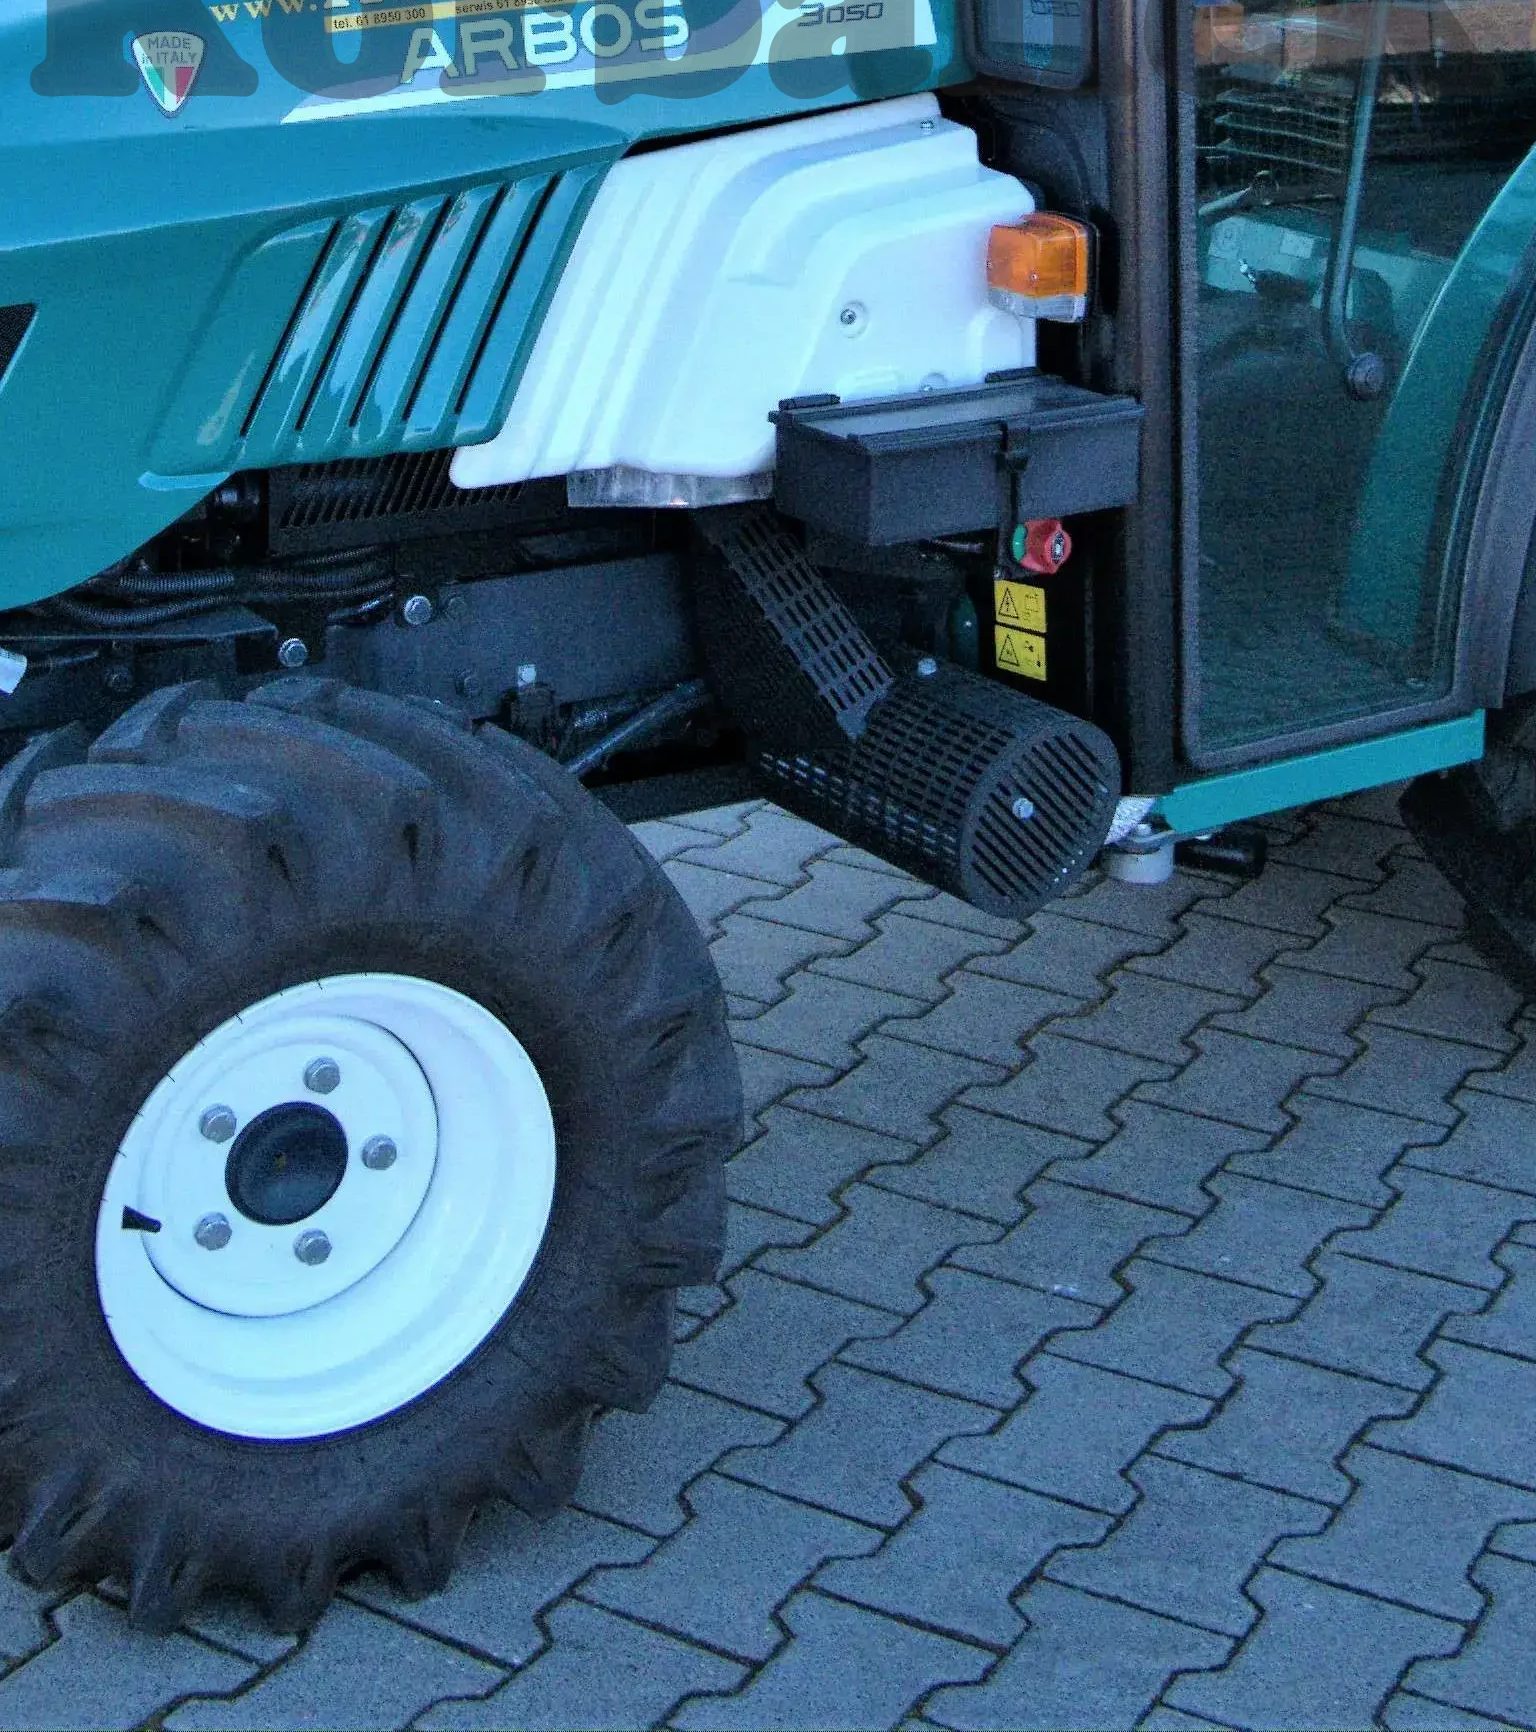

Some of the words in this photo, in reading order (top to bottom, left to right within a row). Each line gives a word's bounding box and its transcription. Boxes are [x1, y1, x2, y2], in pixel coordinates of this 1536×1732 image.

[406, 7, 426, 21] 300
[797, 1, 884, 28] 3050
[148, 35, 192, 50] MADE
[156, 50, 197, 65] ITALY
